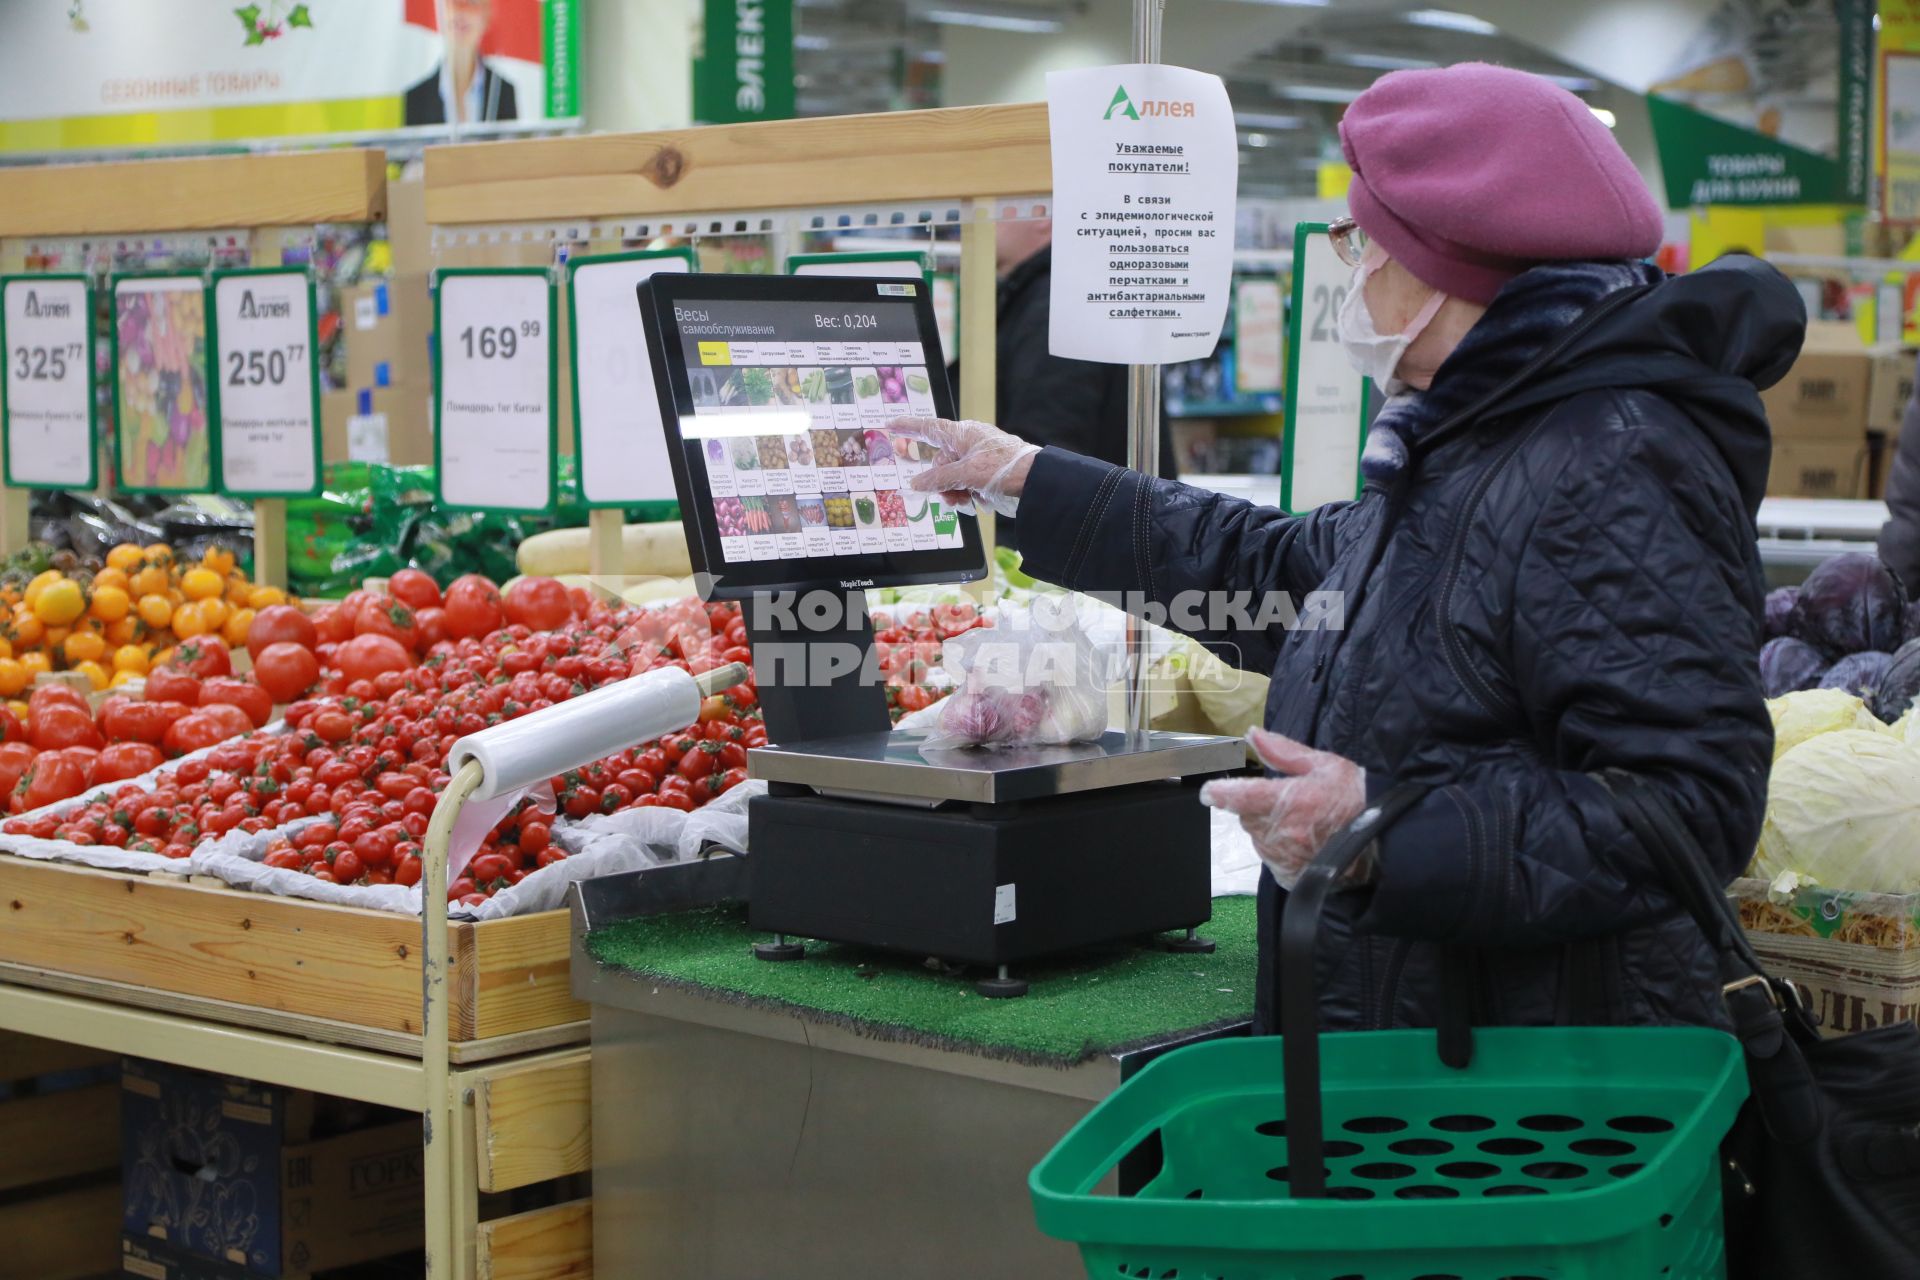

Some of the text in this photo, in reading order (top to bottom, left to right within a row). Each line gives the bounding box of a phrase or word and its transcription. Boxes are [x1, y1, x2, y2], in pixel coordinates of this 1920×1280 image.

[1103, 84, 1196, 120] Аллея
[1116, 143, 1184, 155] Уважаемые
[1108, 161, 1190, 173] покупатели!
[1124, 195, 1171, 204] В связи
[1081, 211, 1214, 221] с эпидемиологической
[1077, 227, 1216, 239] ситуацией, просим вас
[1109, 244, 1189, 253] пользоваться
[1109, 260, 1189, 270] одноразовыми
[1109, 276, 1189, 286] перчатками и
[238, 289, 290, 319] Аллея
[674, 307, 709, 322] Весы
[1109, 307, 1182, 319] салфетками.
[814, 314, 877, 330] Вес: 0,204
[682, 323, 775, 337] самообслуживания
[460, 320, 541, 359] 169 99
[15, 344, 82, 381] 325 77
[227, 345, 305, 386] 250 77
[446, 401, 494, 414] Помидоры
[513, 402, 542, 413] Китай
[935, 514, 955, 523] ДАЛЕЕ
[840, 579, 874, 589] MapleTouch
